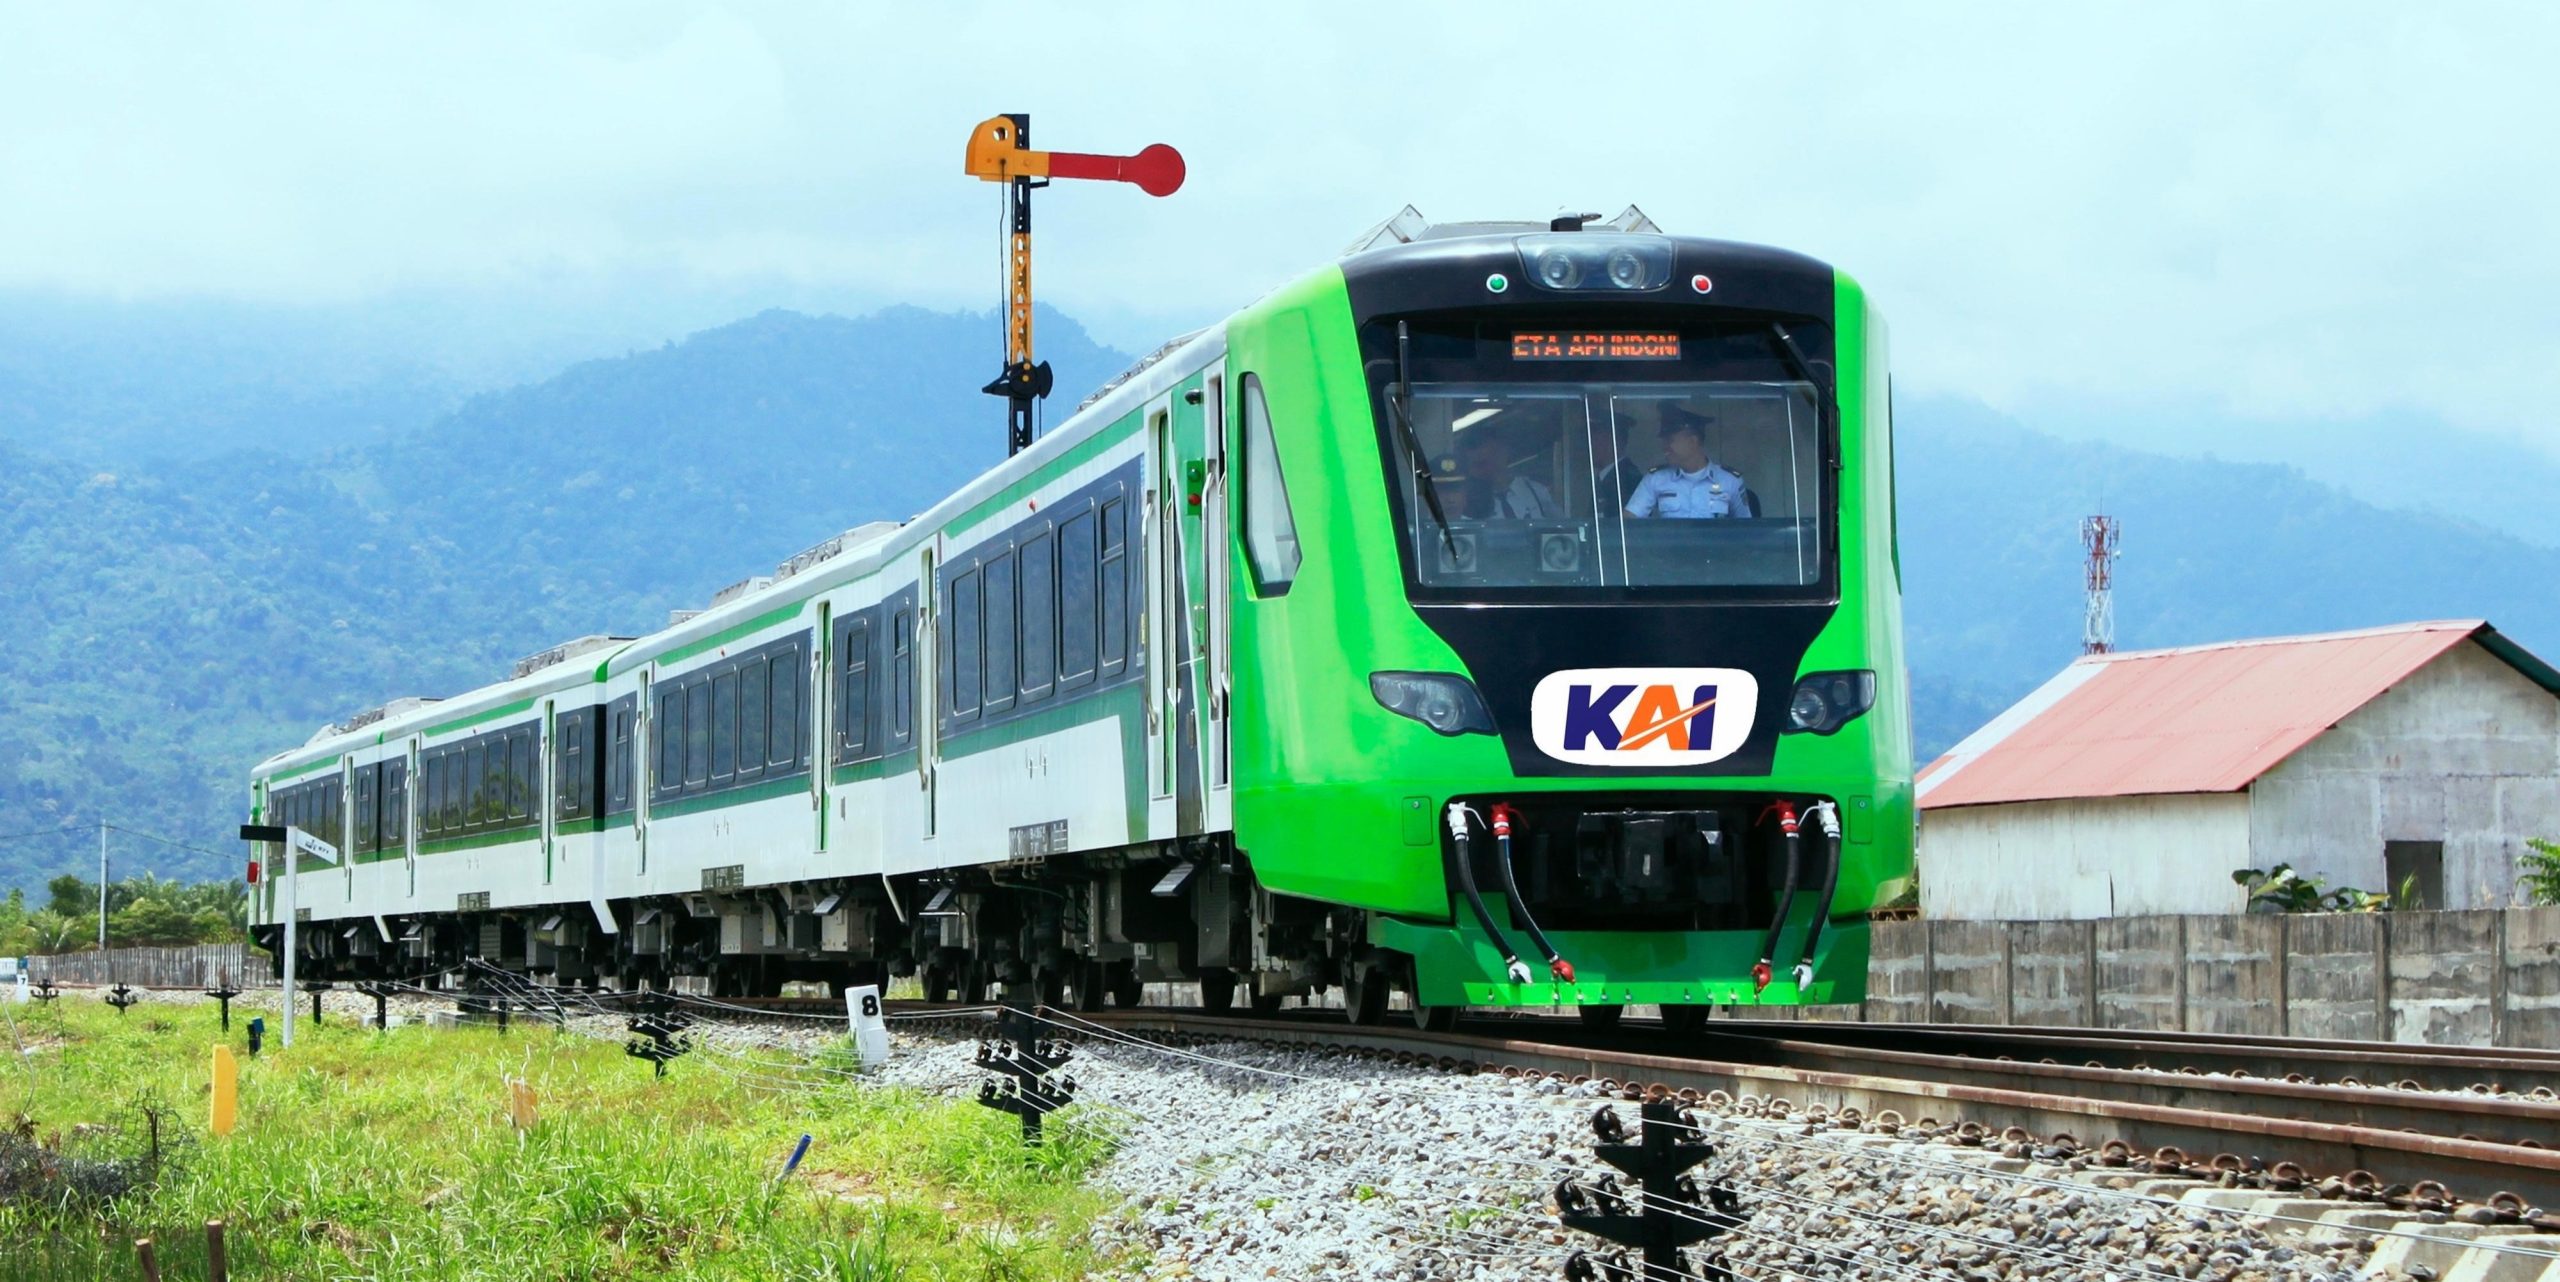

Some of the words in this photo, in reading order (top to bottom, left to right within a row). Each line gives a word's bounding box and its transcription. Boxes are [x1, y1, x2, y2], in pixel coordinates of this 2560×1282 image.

[1513, 334, 1561, 357] ETA
[1567, 334, 1605, 357] API
[1563, 685, 1718, 751] KAI
[862, 995, 879, 1017] 8
